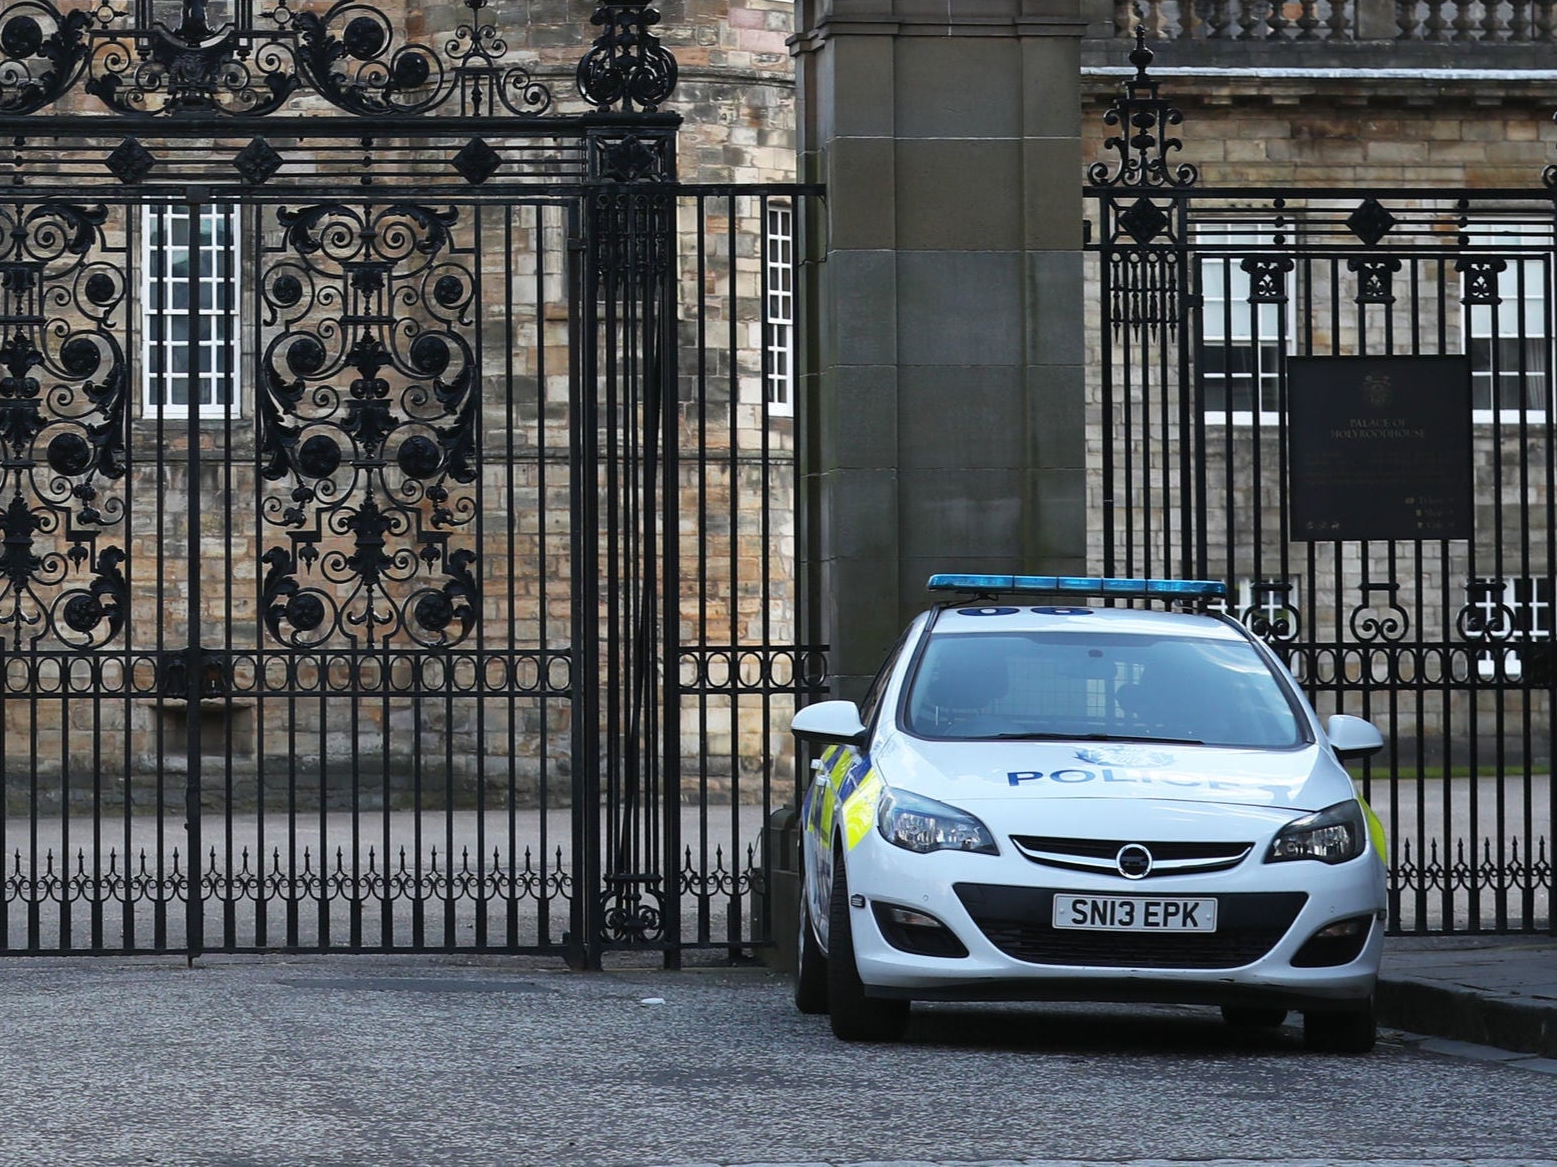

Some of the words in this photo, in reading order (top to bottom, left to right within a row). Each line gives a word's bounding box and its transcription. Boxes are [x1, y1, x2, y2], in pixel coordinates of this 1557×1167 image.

[1349, 419, 1389, 428] PALACE
[1392, 419, 1407, 428] OF
[1330, 429, 1426, 439] HOLYROODHOUSE
[1007, 769, 1241, 789] POLICE
[1071, 899, 1135, 926] SN13
[1144, 901, 1199, 927] EPK
